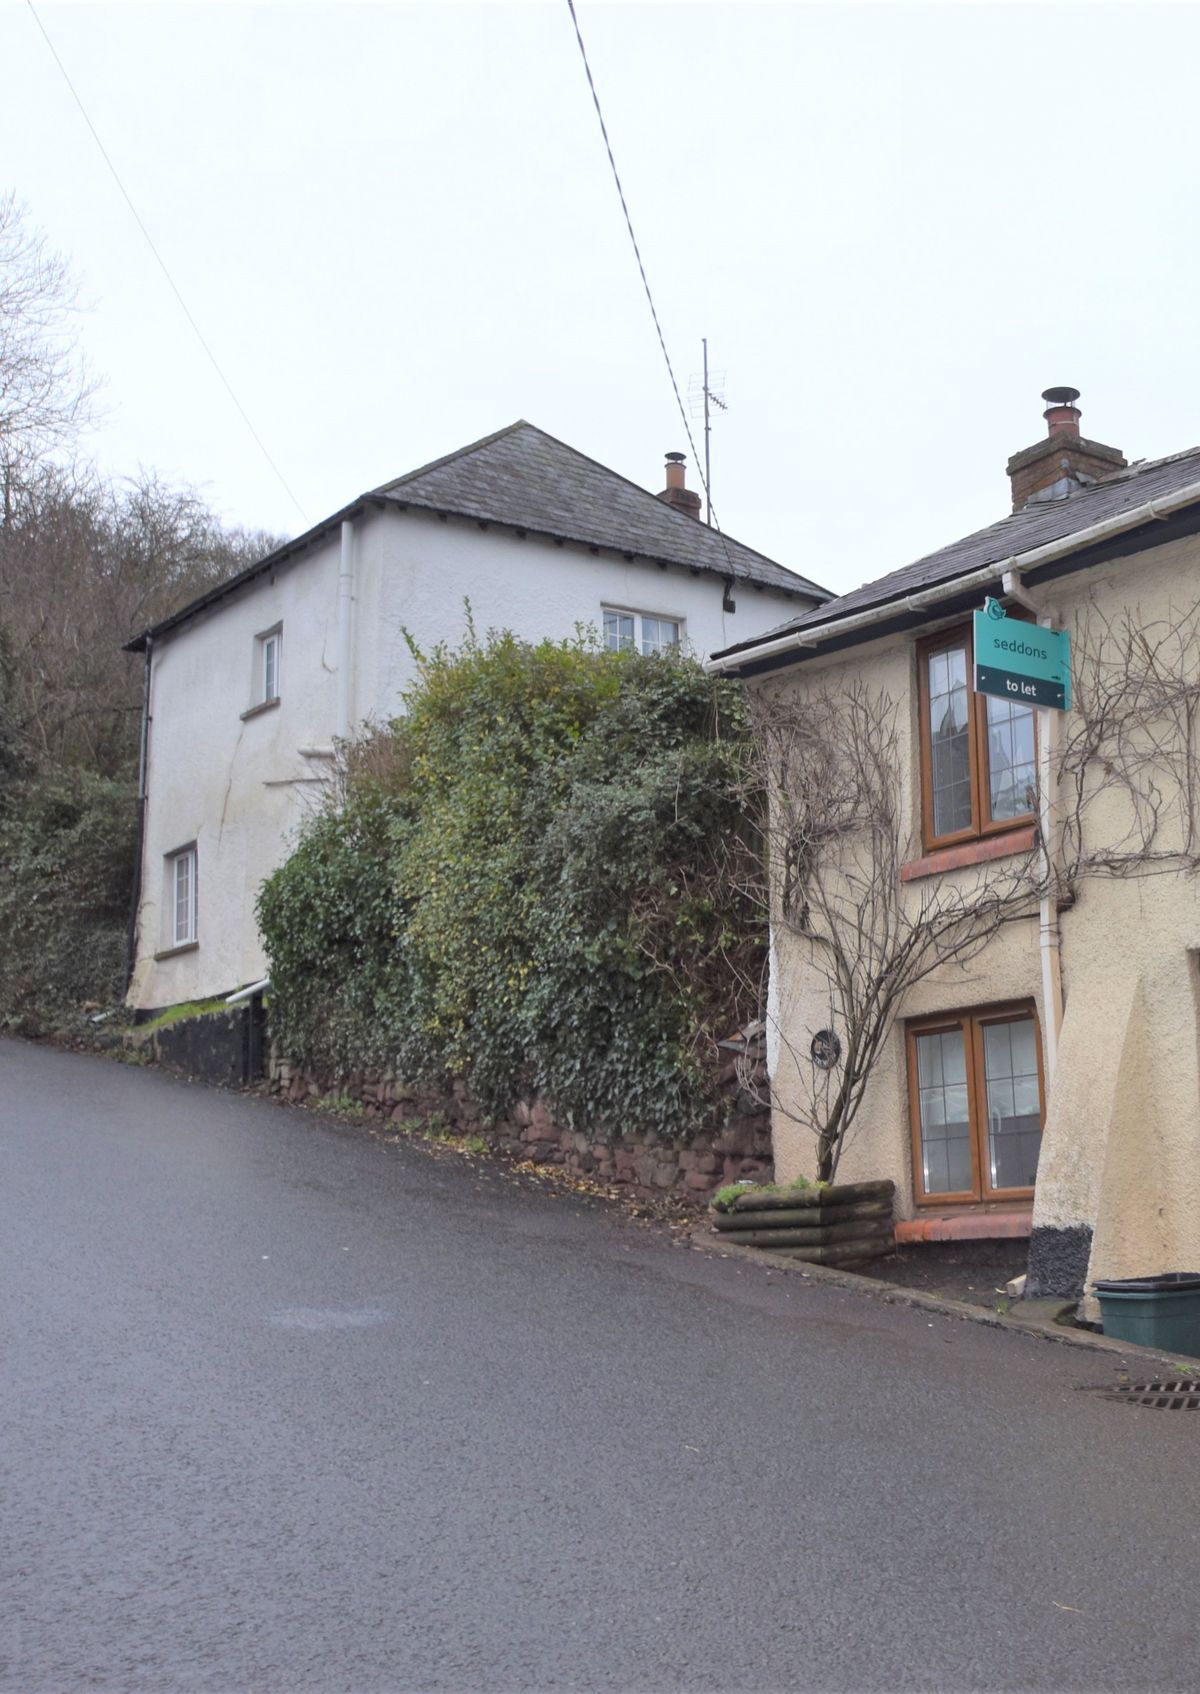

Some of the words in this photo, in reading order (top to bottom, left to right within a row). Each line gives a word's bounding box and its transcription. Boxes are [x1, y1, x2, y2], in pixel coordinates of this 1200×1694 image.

[993, 638, 1048, 660] seddons
[1006, 679, 1018, 692] to
[1021, 681, 1037, 696] let
